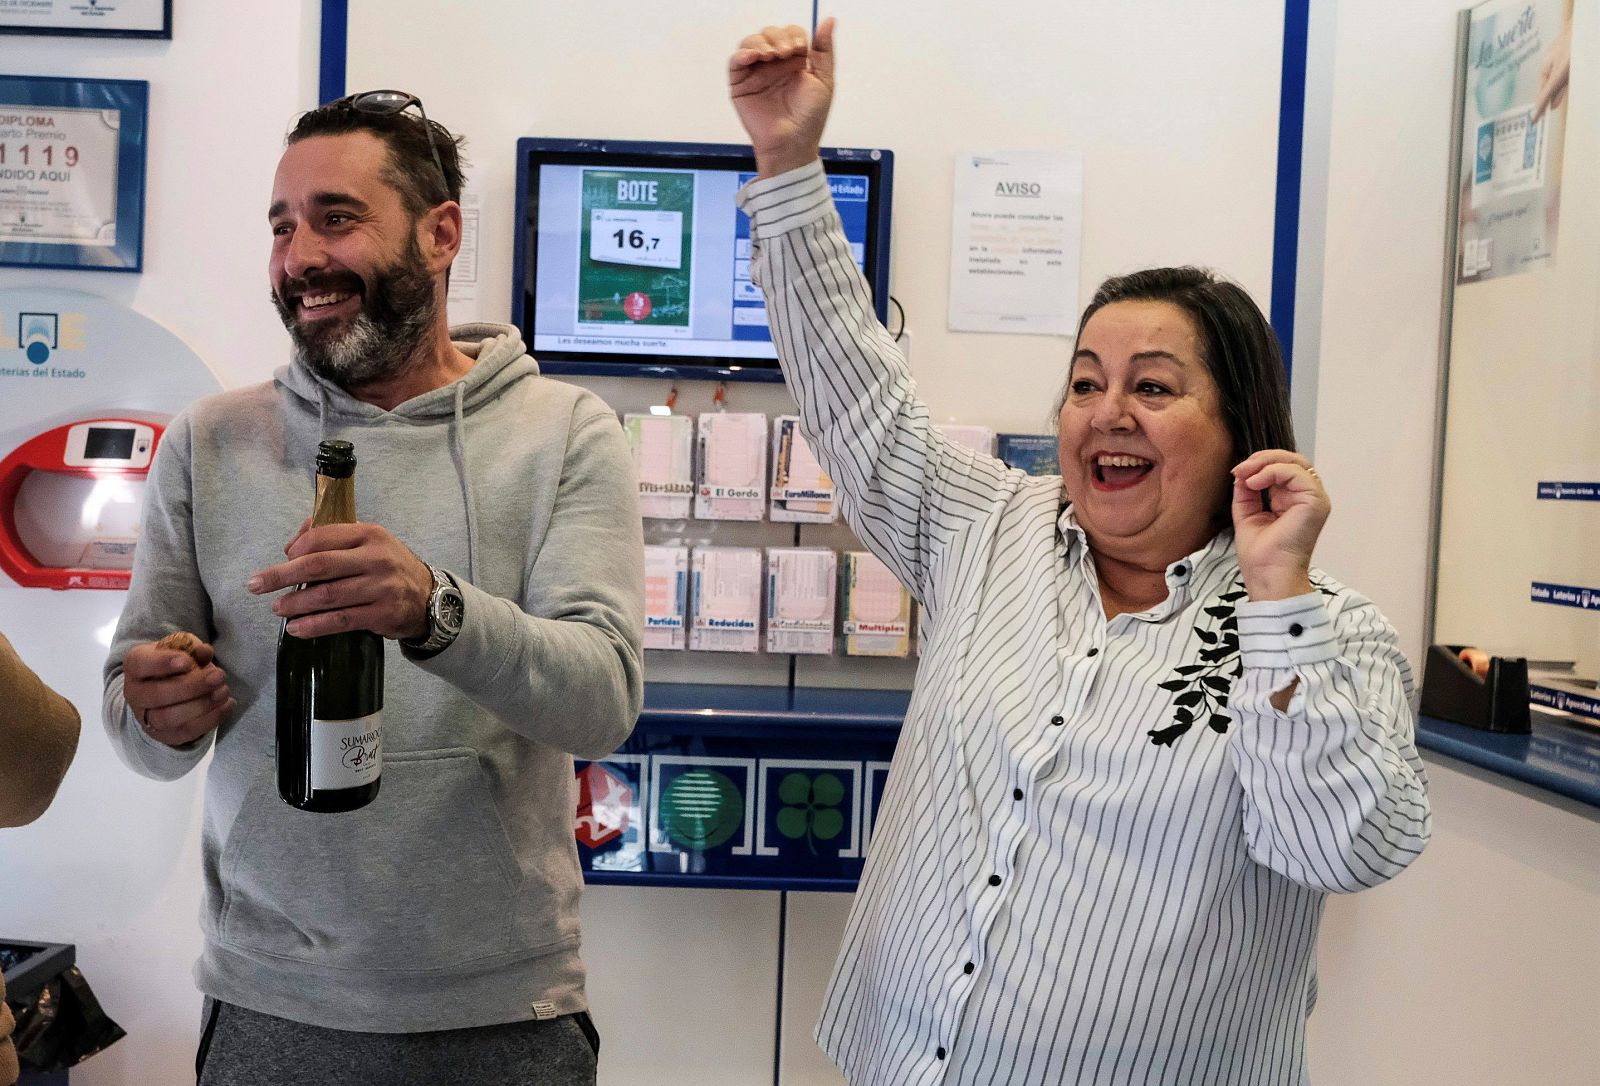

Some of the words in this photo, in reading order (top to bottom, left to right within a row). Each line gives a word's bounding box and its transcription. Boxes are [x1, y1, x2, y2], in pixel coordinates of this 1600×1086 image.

[617, 180, 658, 202] BOTE
[995, 182, 1041, 194] AVISO
[613, 229, 660, 252] 16,7
[32, 367, 48, 377] del
[52, 368, 86, 378] Estado
[715, 488, 724, 497] El
[728, 489, 758, 497] Gordo
[708, 619, 754, 628] Reducidas
